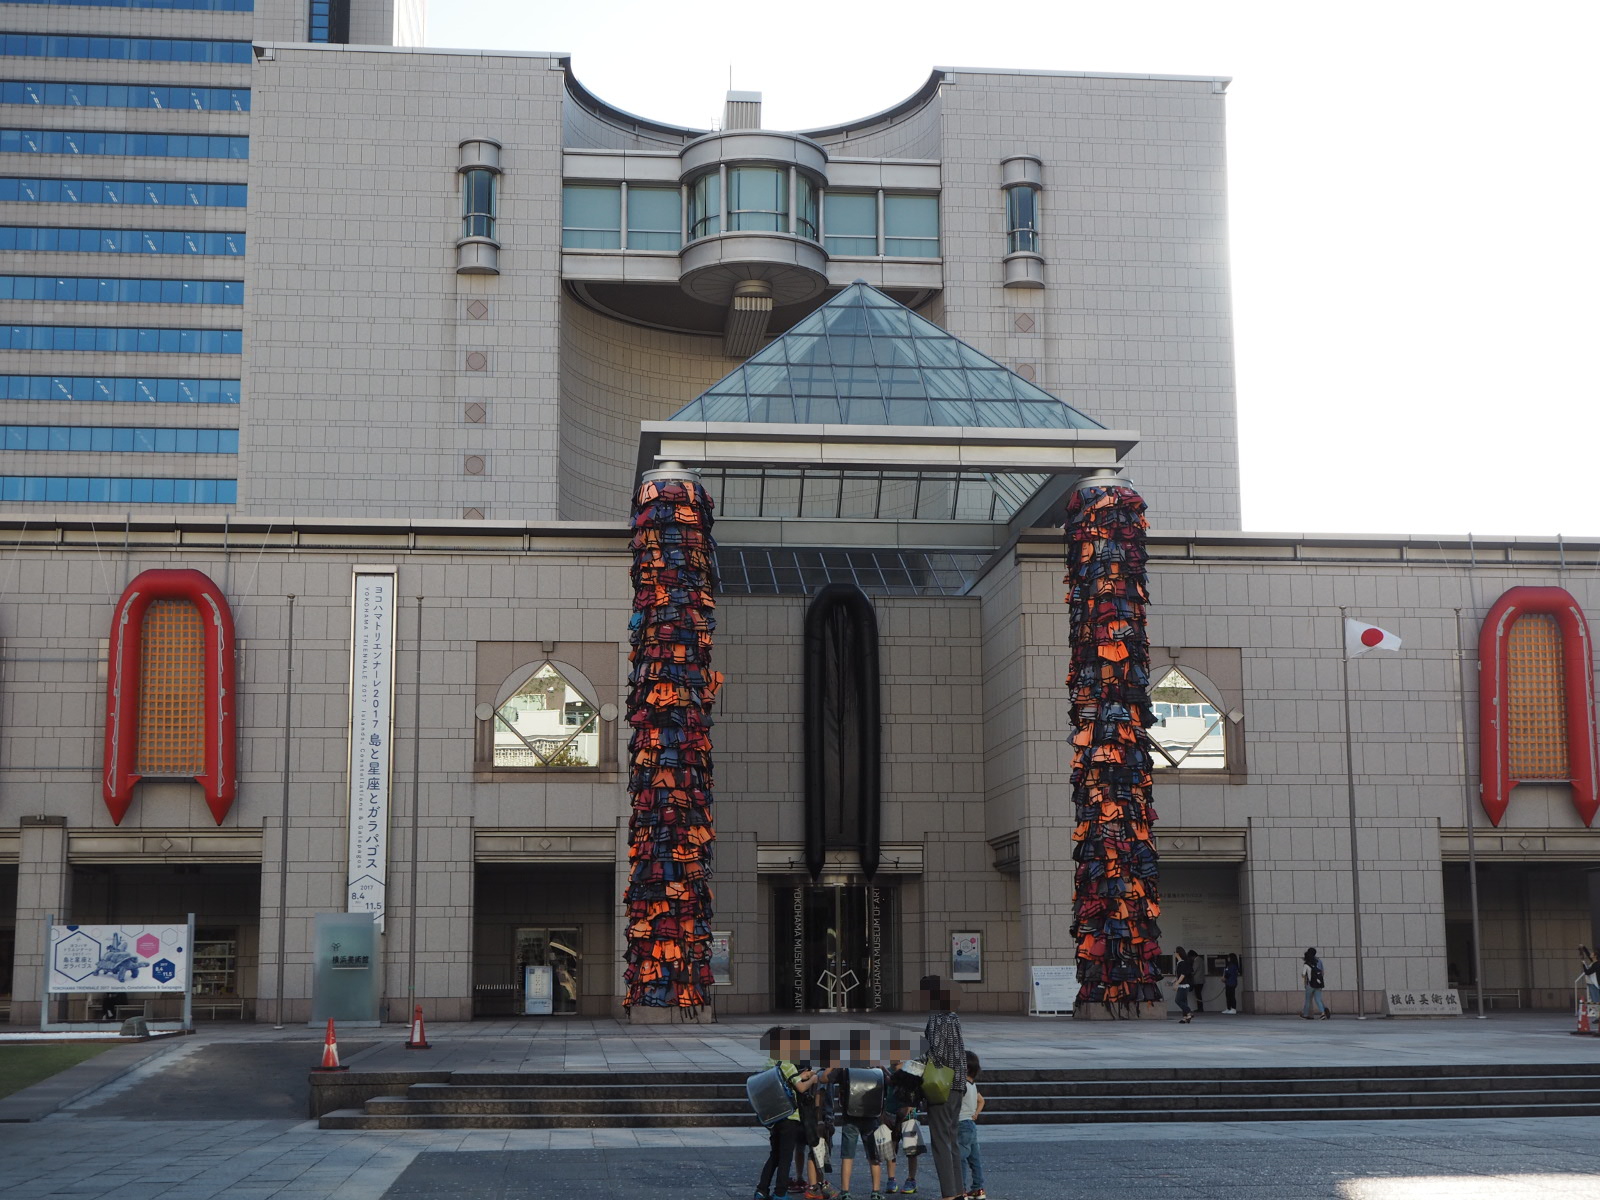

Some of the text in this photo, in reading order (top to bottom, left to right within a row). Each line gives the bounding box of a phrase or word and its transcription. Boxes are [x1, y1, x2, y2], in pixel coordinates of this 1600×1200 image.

[361, 634, 369, 680] TRIENNALE
[366, 586, 383, 869] ヨコハマトリエンナーレ2017 島と星座とガラパゴス
[351, 892, 365, 900] 8.4
[365, 902, 382, 910] 11.5
[873, 904, 881, 917] OF
[794, 887, 802, 1009] YOKOHAMA MUSEUM OF ART
[873, 918, 881, 957] MUSEUM
[333, 955, 369, 964] 横浜美術館
[873, 959, 882, 1009] YOKOHAMA
